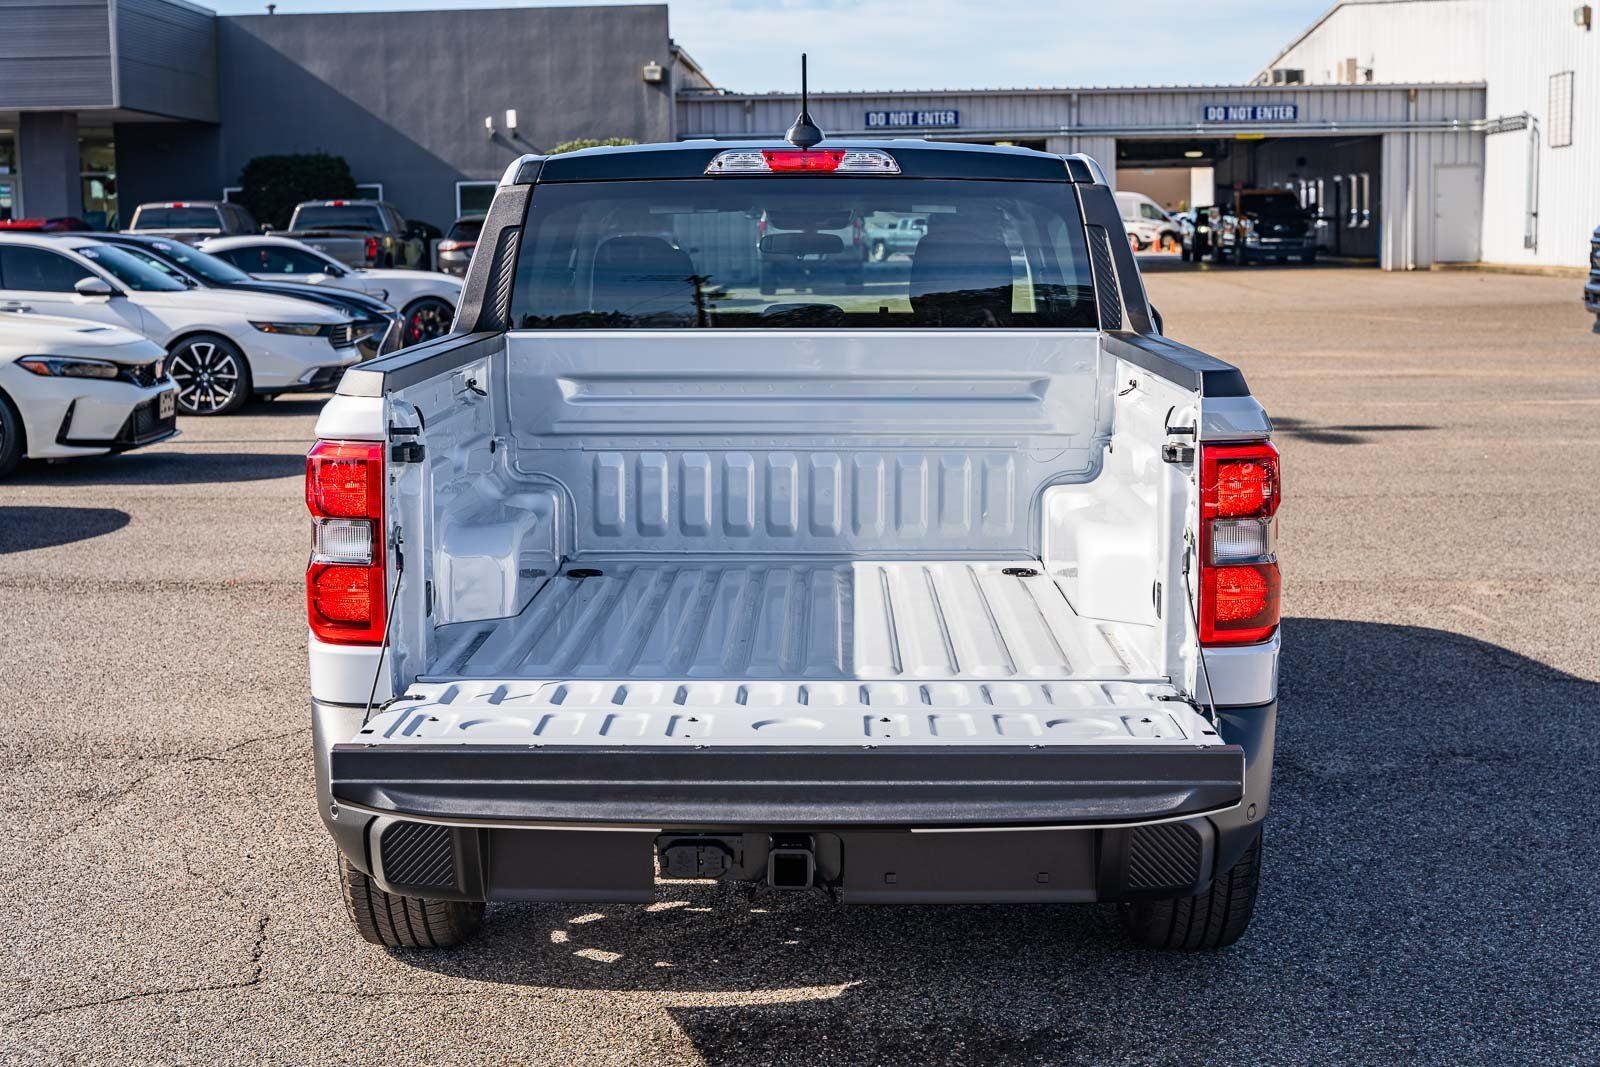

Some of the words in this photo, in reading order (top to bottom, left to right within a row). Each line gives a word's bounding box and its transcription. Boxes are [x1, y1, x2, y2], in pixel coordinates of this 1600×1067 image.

[868, 112, 886, 126] DO
[889, 112, 914, 126] NOT
[917, 111, 955, 125] ENTER
[1207, 107, 1225, 120] DO
[1228, 106, 1252, 120] NOT
[1256, 105, 1294, 119] ENTER
